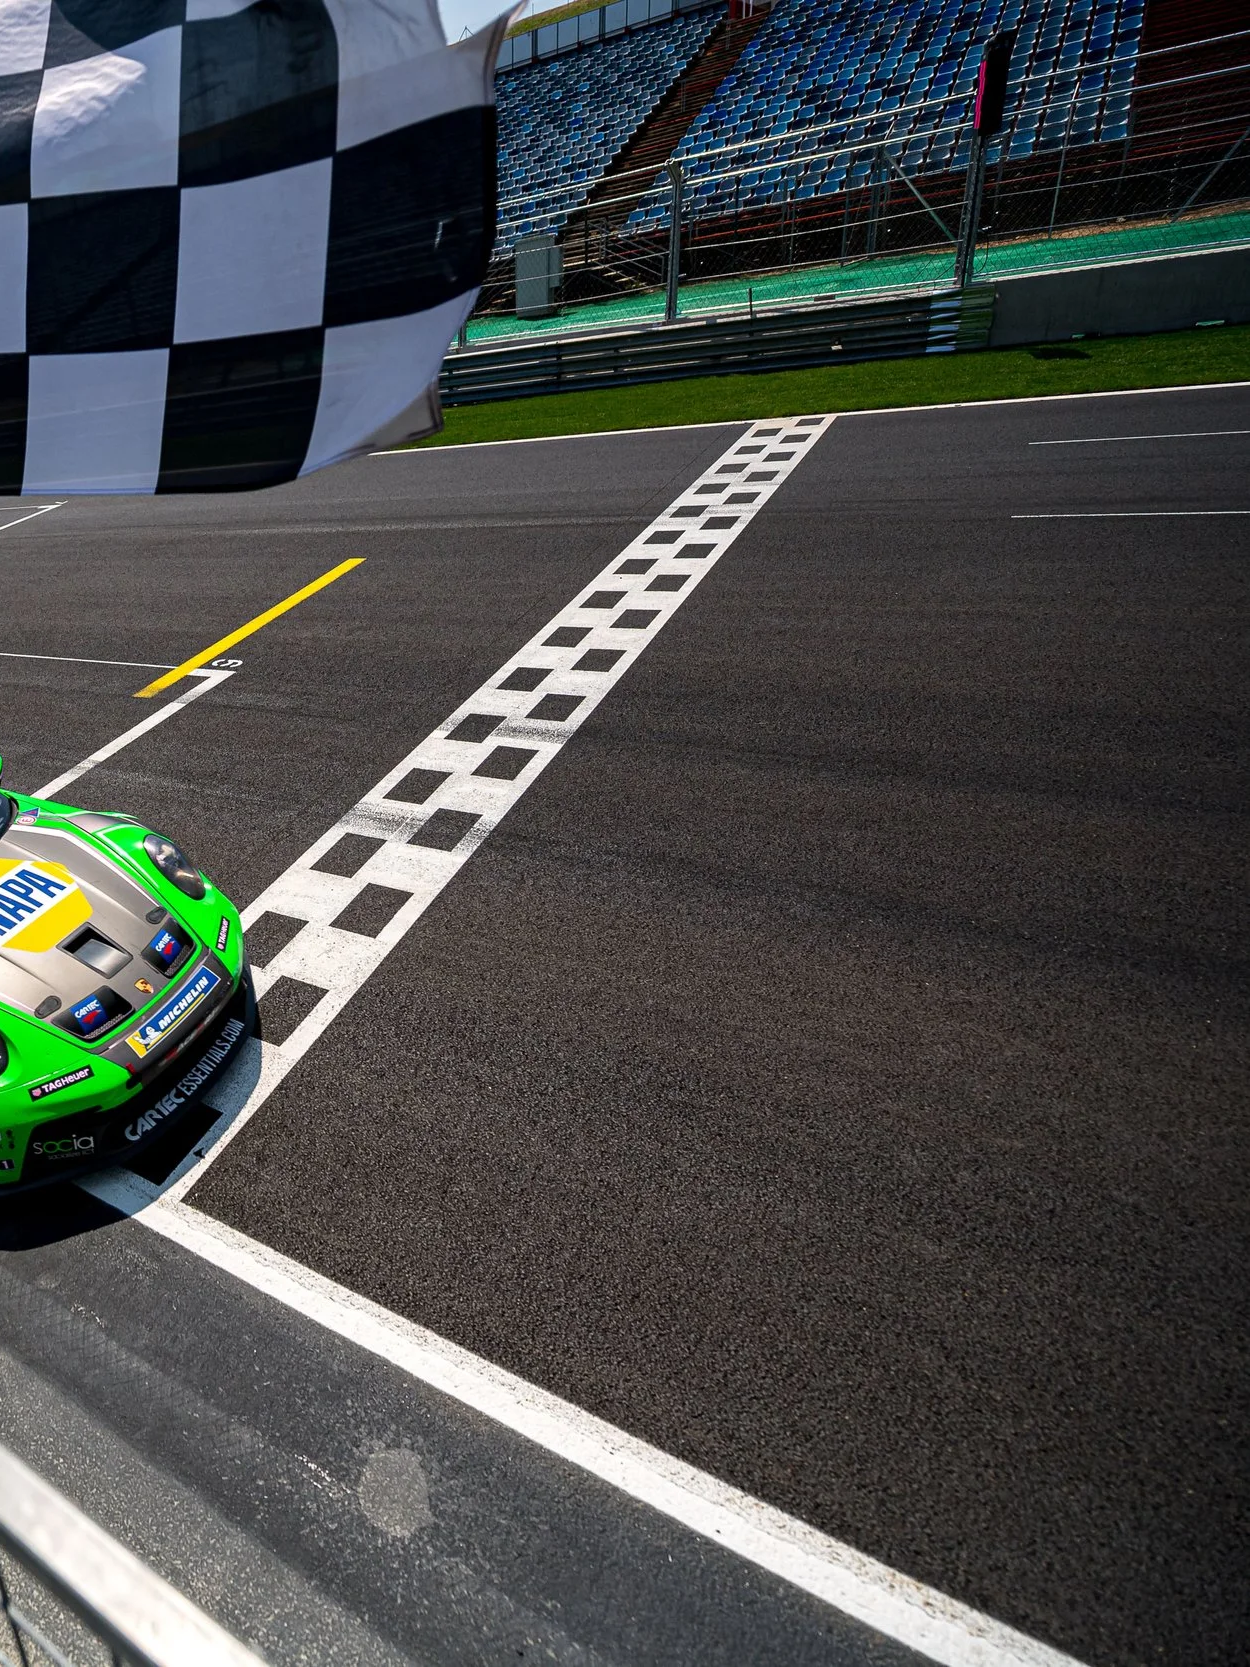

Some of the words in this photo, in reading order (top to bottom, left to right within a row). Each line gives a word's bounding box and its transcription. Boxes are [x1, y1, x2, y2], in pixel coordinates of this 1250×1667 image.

[155, 932, 172, 952] CARTEC
[74, 1000, 100, 1018] CARTEC
[158, 976, 209, 1030] MICHELIN
[124, 1087, 185, 1141] CARTEC
[178, 1018, 245, 1096] ESSENTIALS.COM
[33, 1134, 95, 1155] socia
